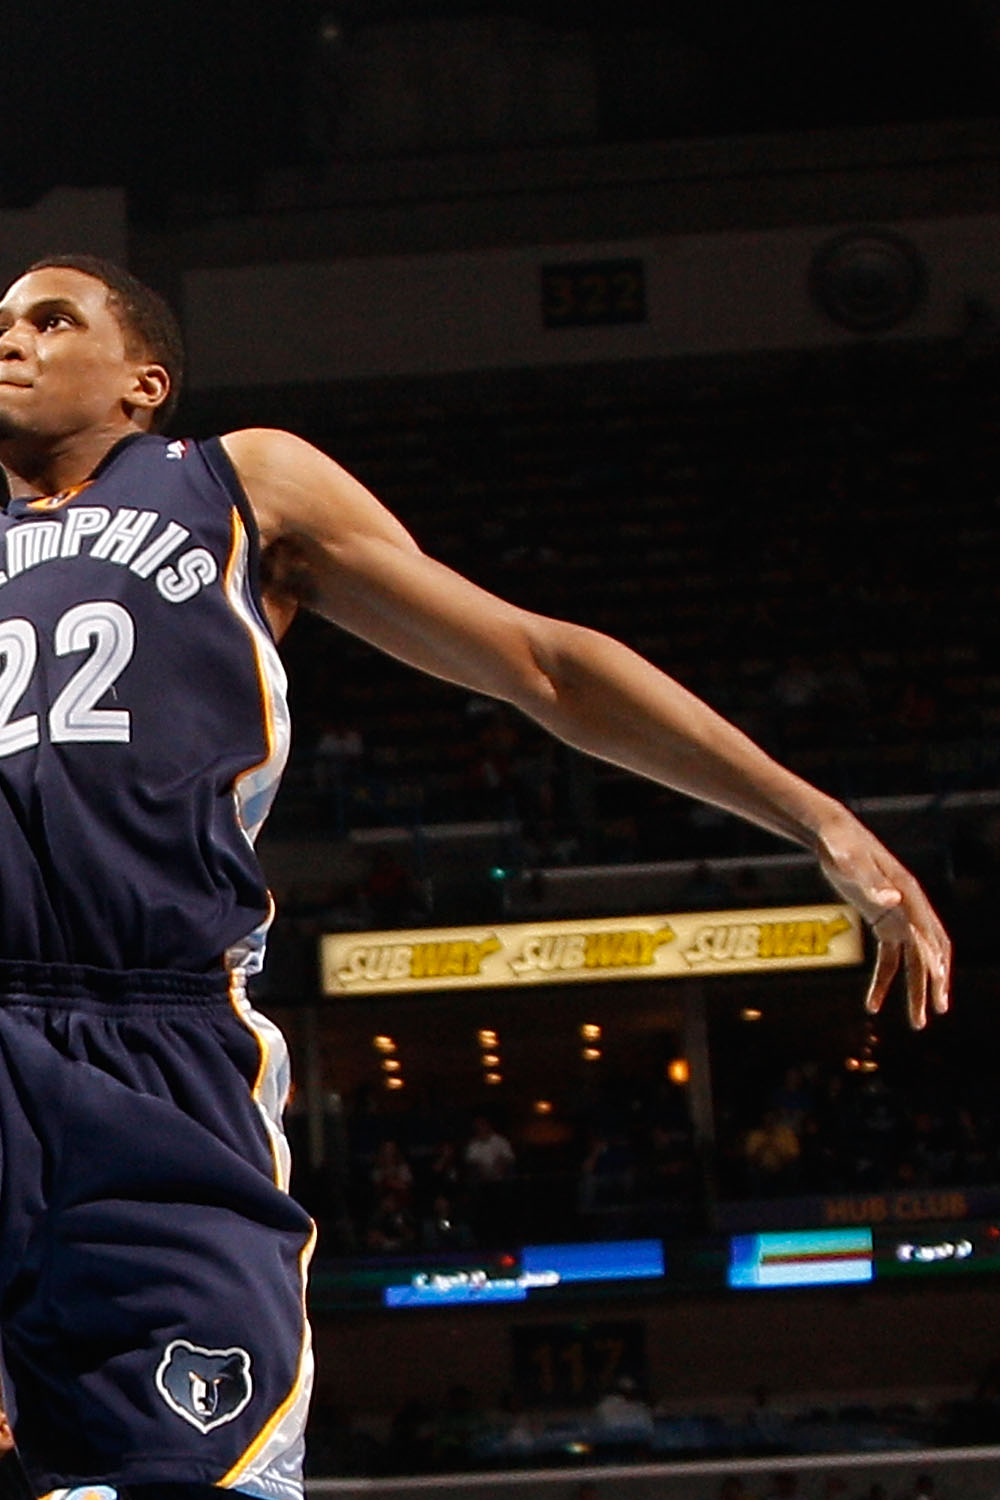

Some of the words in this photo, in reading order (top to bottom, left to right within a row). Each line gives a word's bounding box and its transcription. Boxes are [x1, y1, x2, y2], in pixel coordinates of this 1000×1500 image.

[544, 273, 642, 315] 322
[335, 934, 501, 984] SUBWAY
[509, 922, 676, 977] SUBWAY
[681, 912, 850, 968] SUBWAY
[826, 1197, 886, 1223] HUB
[896, 1192, 967, 1221] CLUB
[529, 1339, 624, 1395] 117
